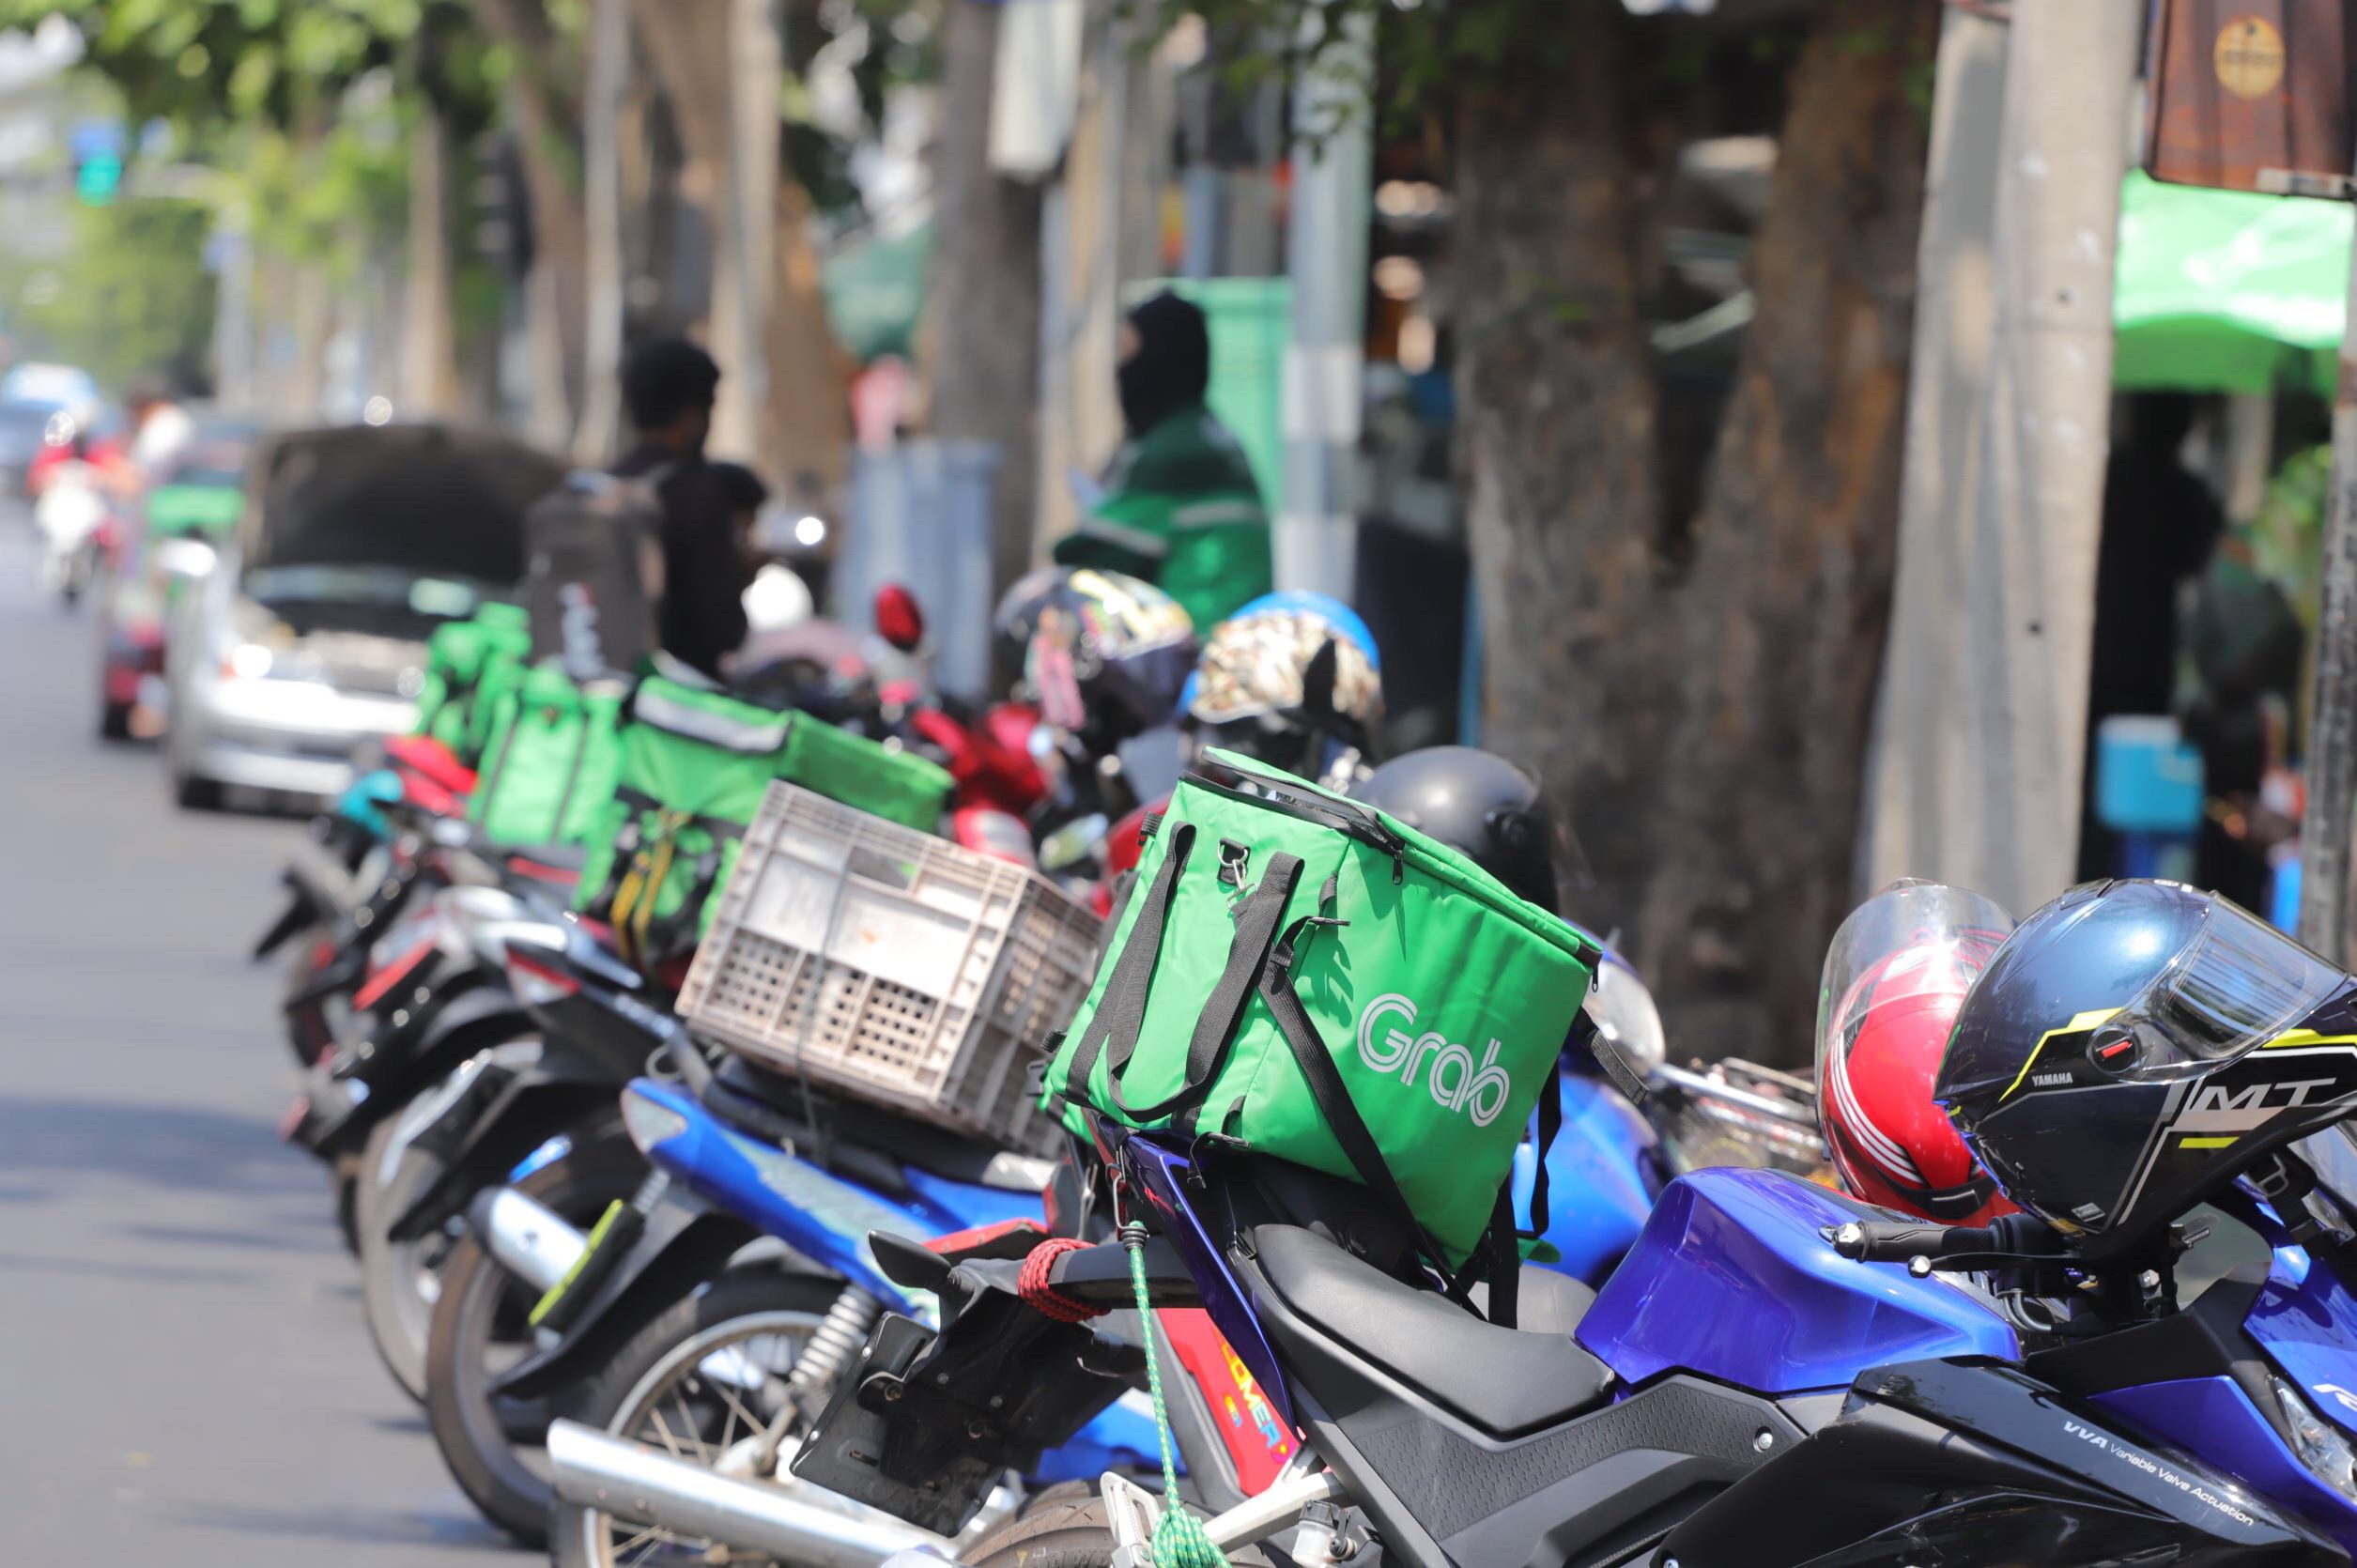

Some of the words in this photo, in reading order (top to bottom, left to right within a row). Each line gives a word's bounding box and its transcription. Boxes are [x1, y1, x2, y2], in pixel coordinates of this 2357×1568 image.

[1357, 992, 1510, 1127] Grab
[2031, 1071, 2073, 1087] YAMAHA
[2189, 1077, 2337, 1113] MT
[1215, 1330, 1282, 1449] OMER
[2063, 1421, 2109, 1450] VVA
[2110, 1442, 2157, 1473] Variable
[2159, 1467, 2191, 1491] Valve
[2190, 1486, 2255, 1527] Actuation
